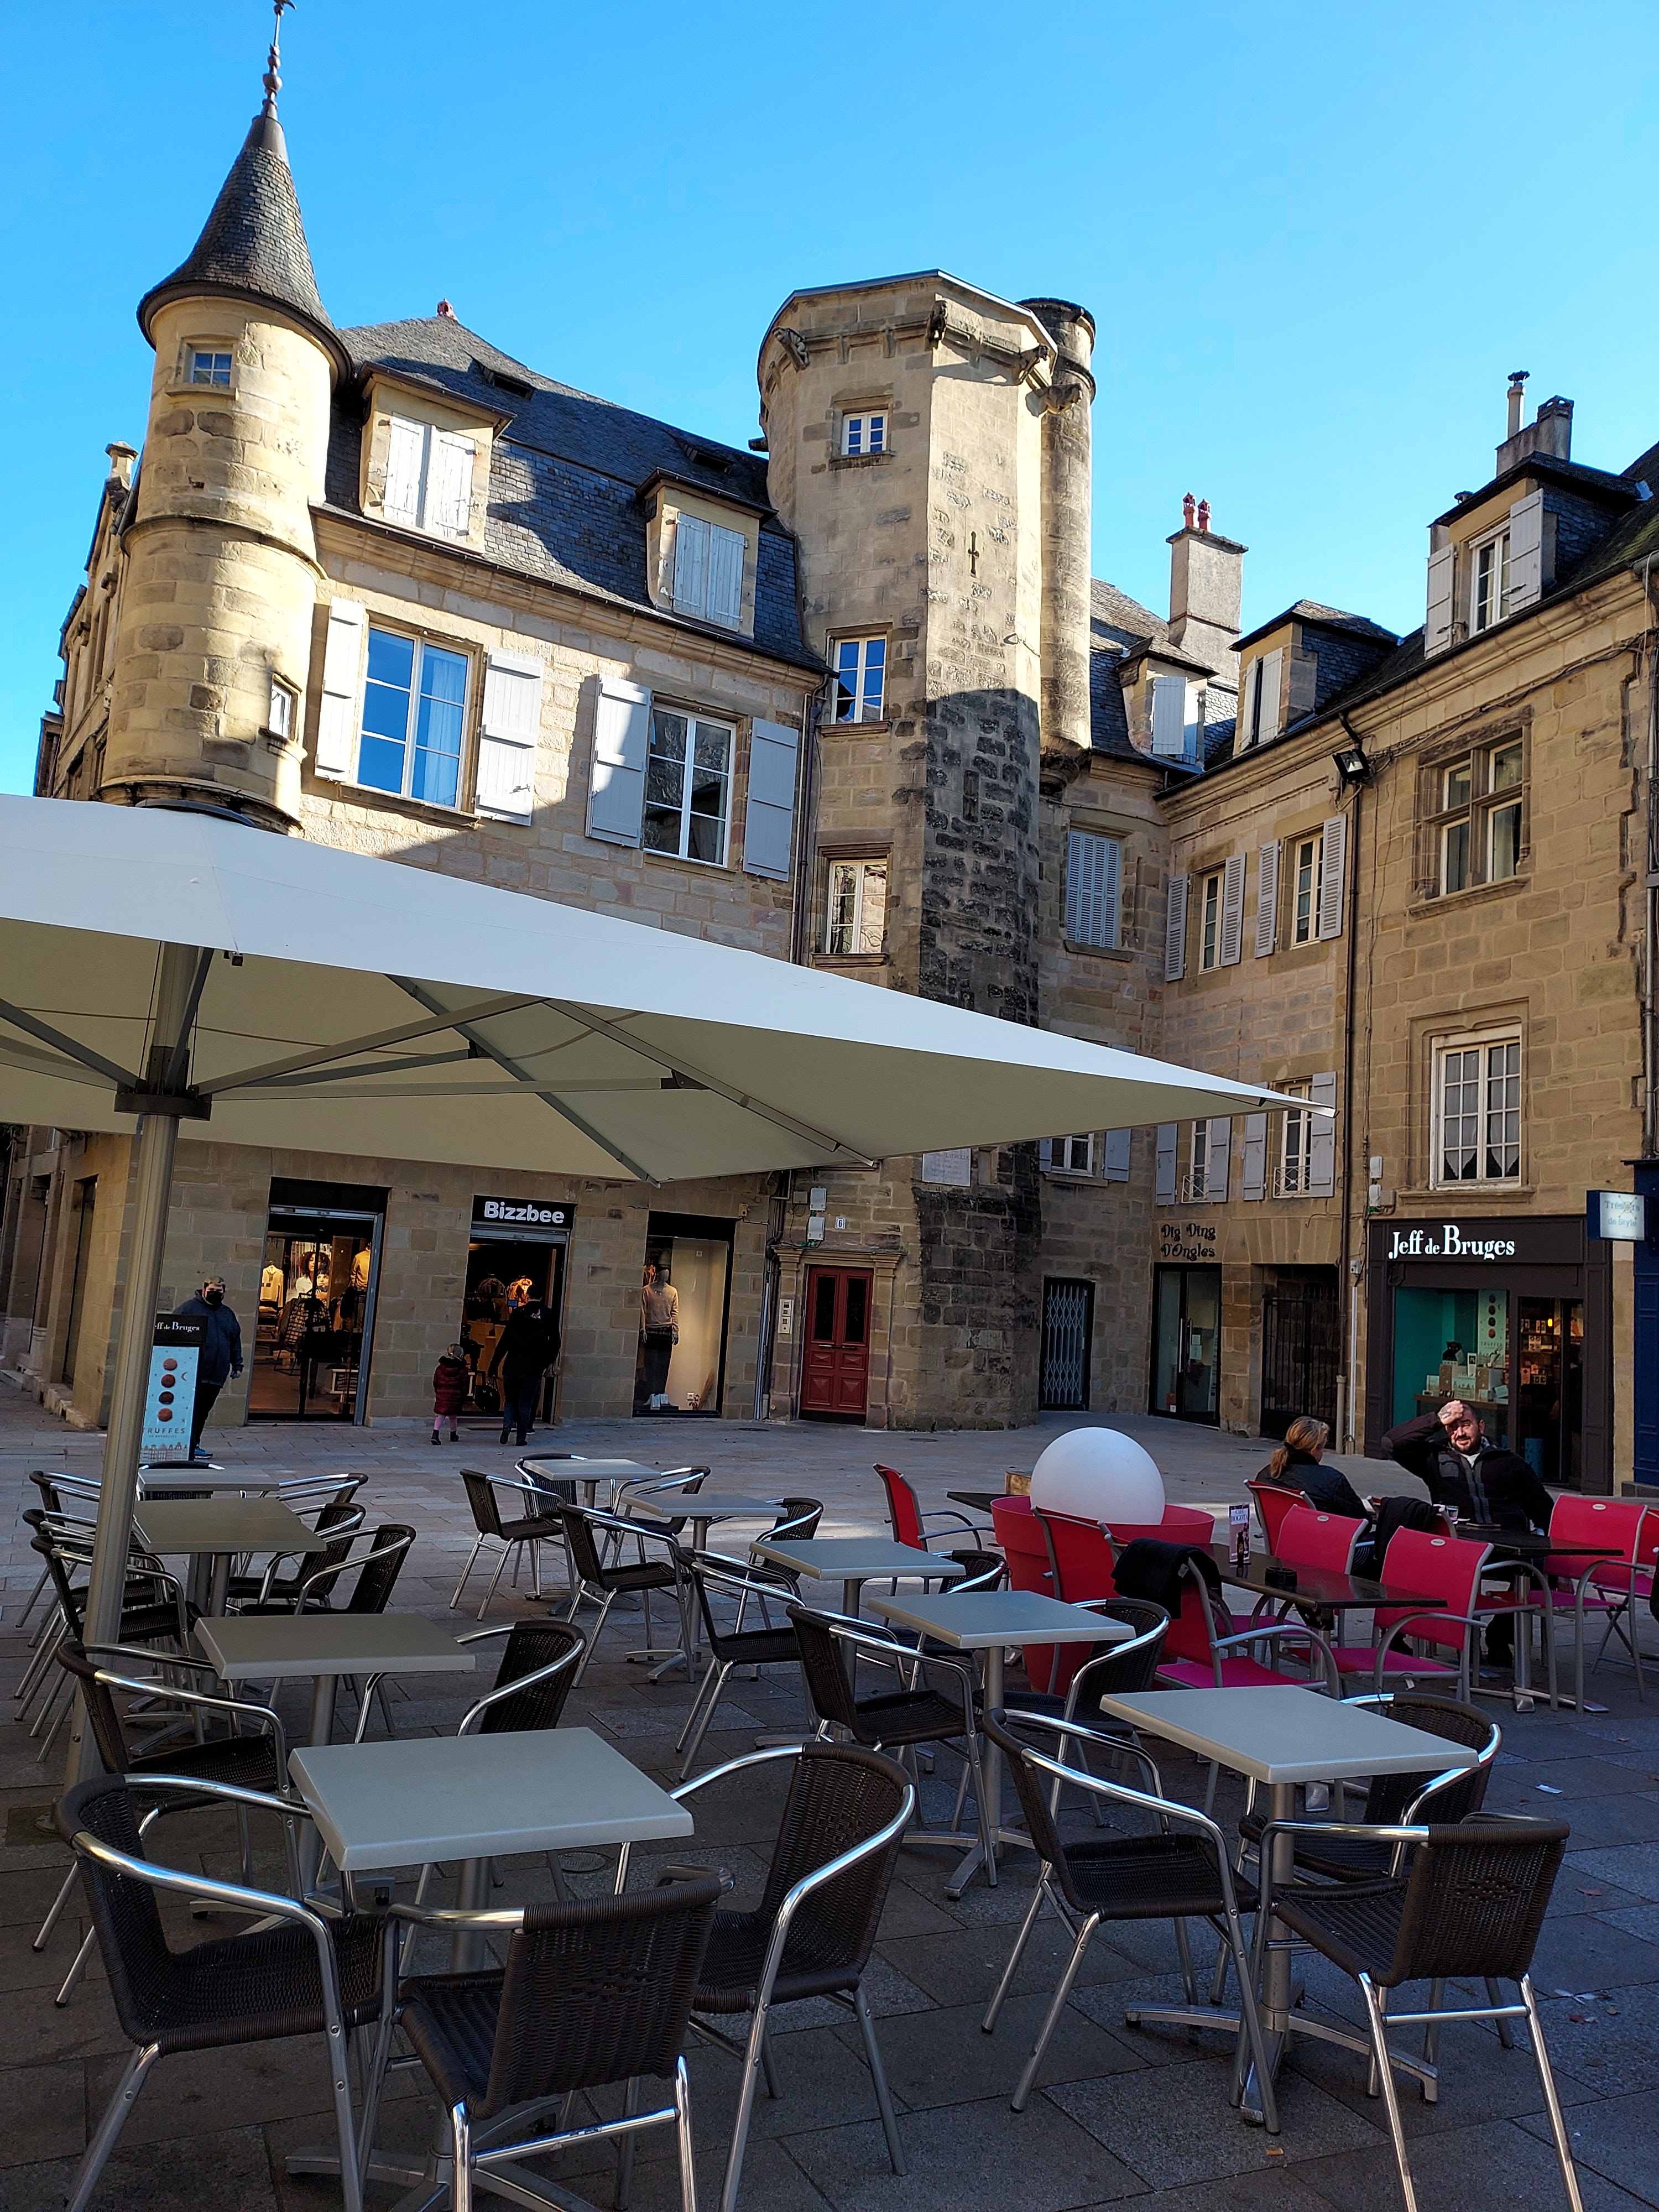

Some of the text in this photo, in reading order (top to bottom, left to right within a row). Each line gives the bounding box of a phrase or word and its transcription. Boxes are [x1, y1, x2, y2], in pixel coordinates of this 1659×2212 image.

[484, 1201, 565, 1224] Bizzbee
[838, 1219, 843, 1228] 6
[1186, 1223, 1216, 1241] Ding
[1388, 1225, 1515, 1260] Jeff de Bruges
[1161, 1243, 1215, 1261] D'Ongles
[172, 1321, 200, 1333] Bruges
